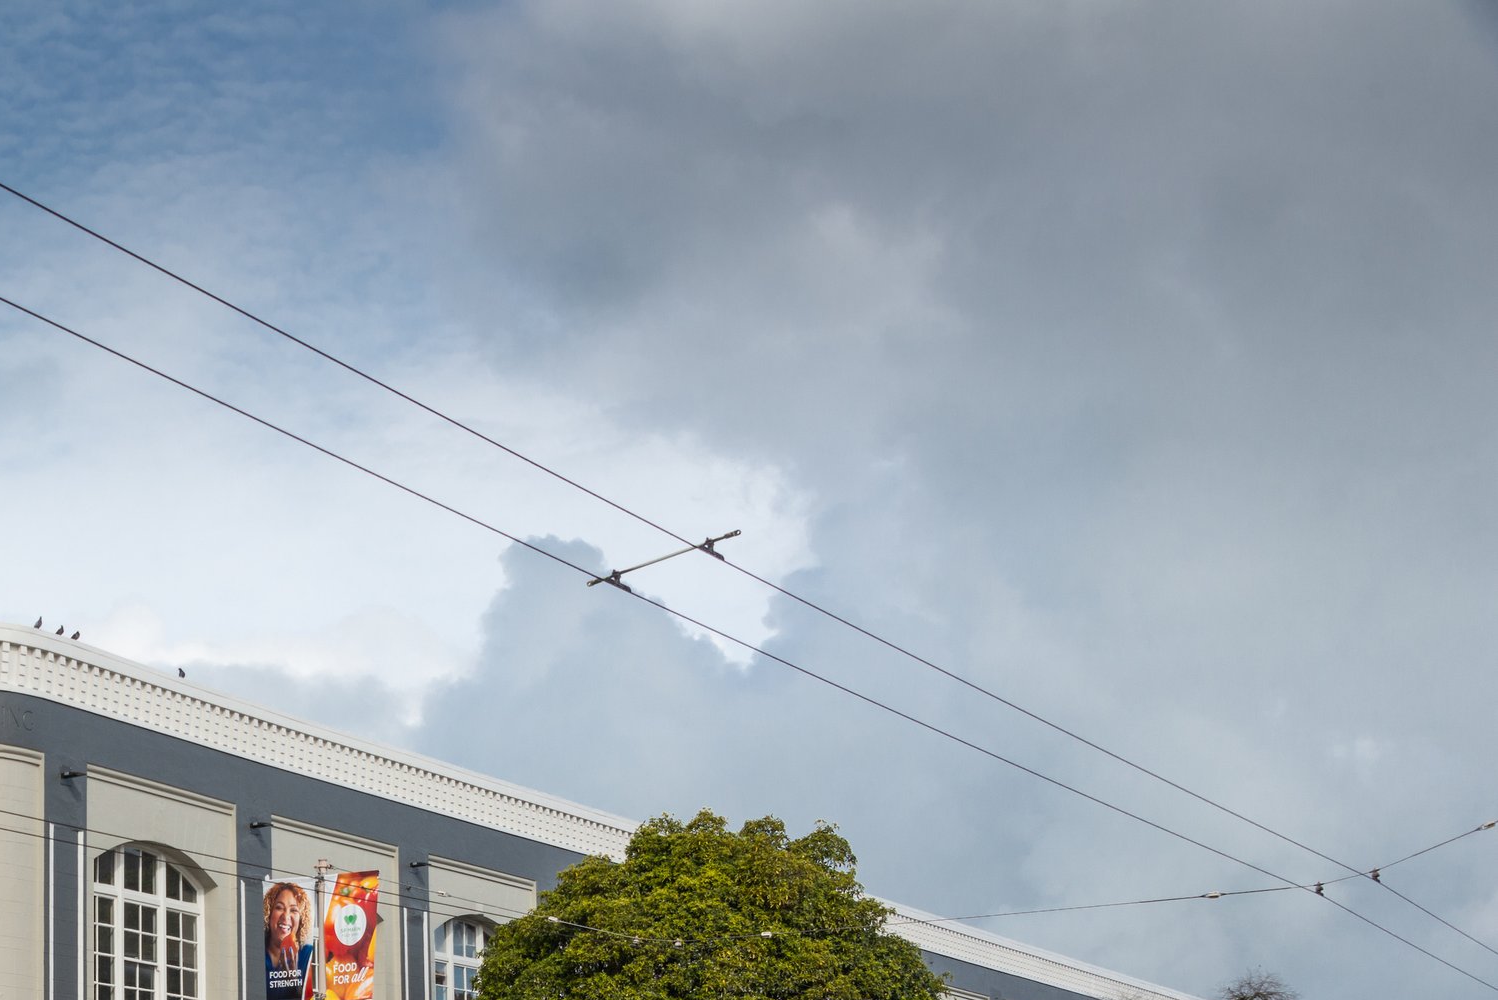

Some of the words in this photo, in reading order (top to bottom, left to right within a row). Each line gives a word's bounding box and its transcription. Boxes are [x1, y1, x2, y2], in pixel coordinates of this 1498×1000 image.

[333, 962, 357, 973] FOOD
[269, 971, 288, 979] FOOD
[288, 969, 302, 978] FOR
[333, 975, 349, 985] FOR
[351, 966, 369, 983] all
[269, 979, 302, 989] STRENGTH
